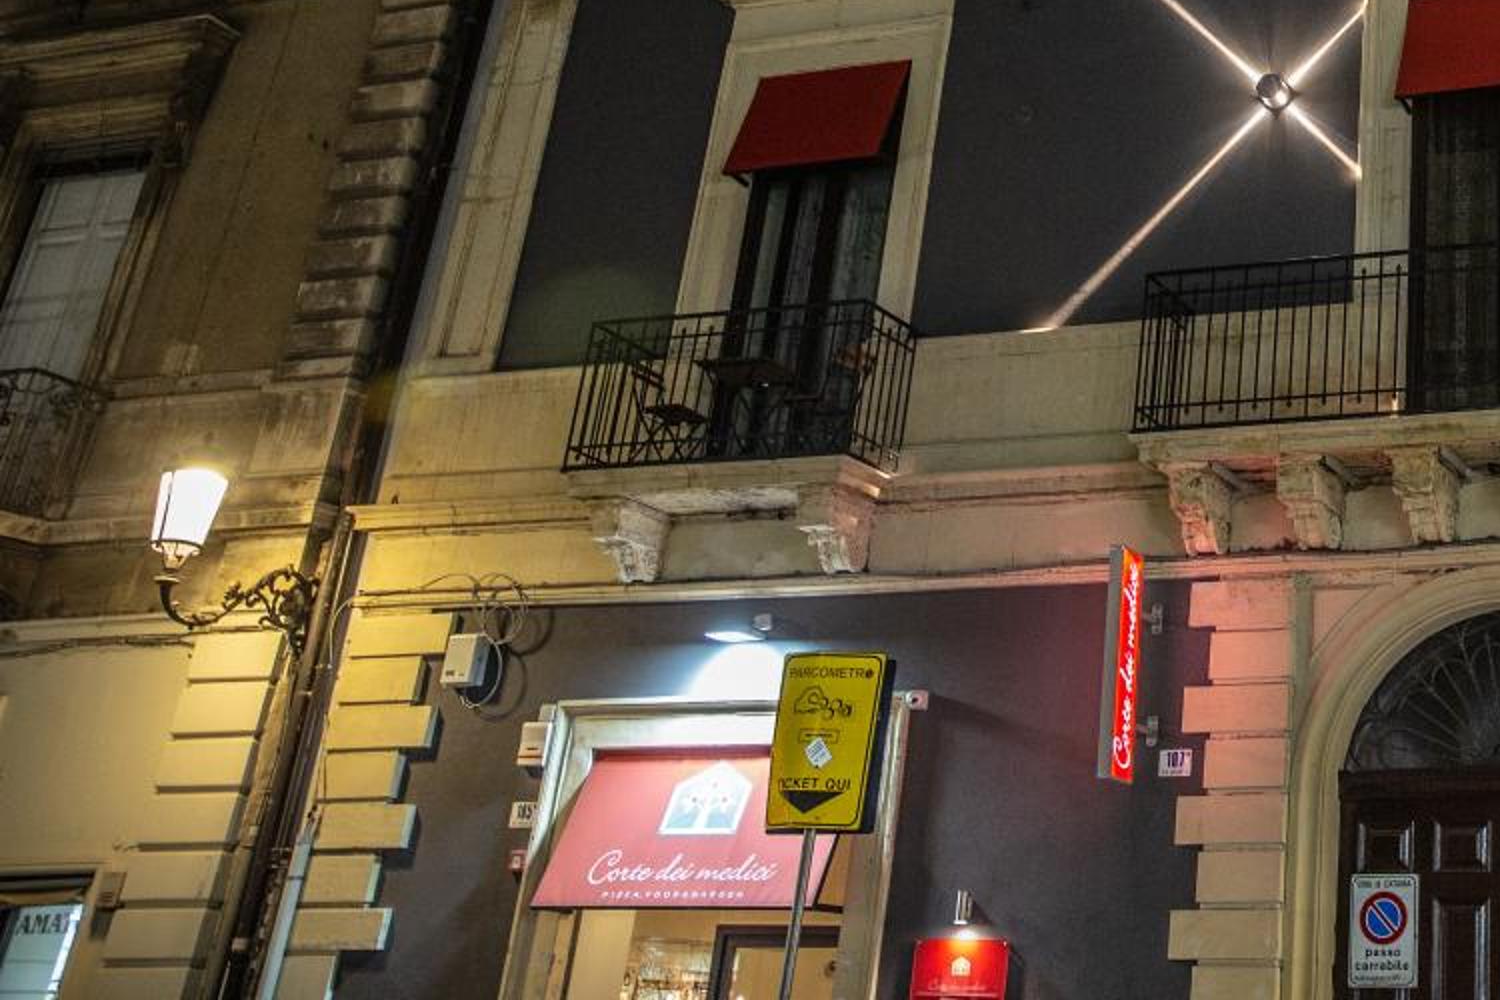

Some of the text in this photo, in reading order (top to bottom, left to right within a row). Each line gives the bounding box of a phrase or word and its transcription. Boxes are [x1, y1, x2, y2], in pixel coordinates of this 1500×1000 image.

[790, 667, 875, 680] PARCOMETRO
[1167, 751, 1185, 768] 107
[825, 777, 851, 792] QUI
[587, 849, 778, 885] Corte dei medici
[1366, 949, 1400, 960] passo
[1355, 961, 1409, 971] carrabile
